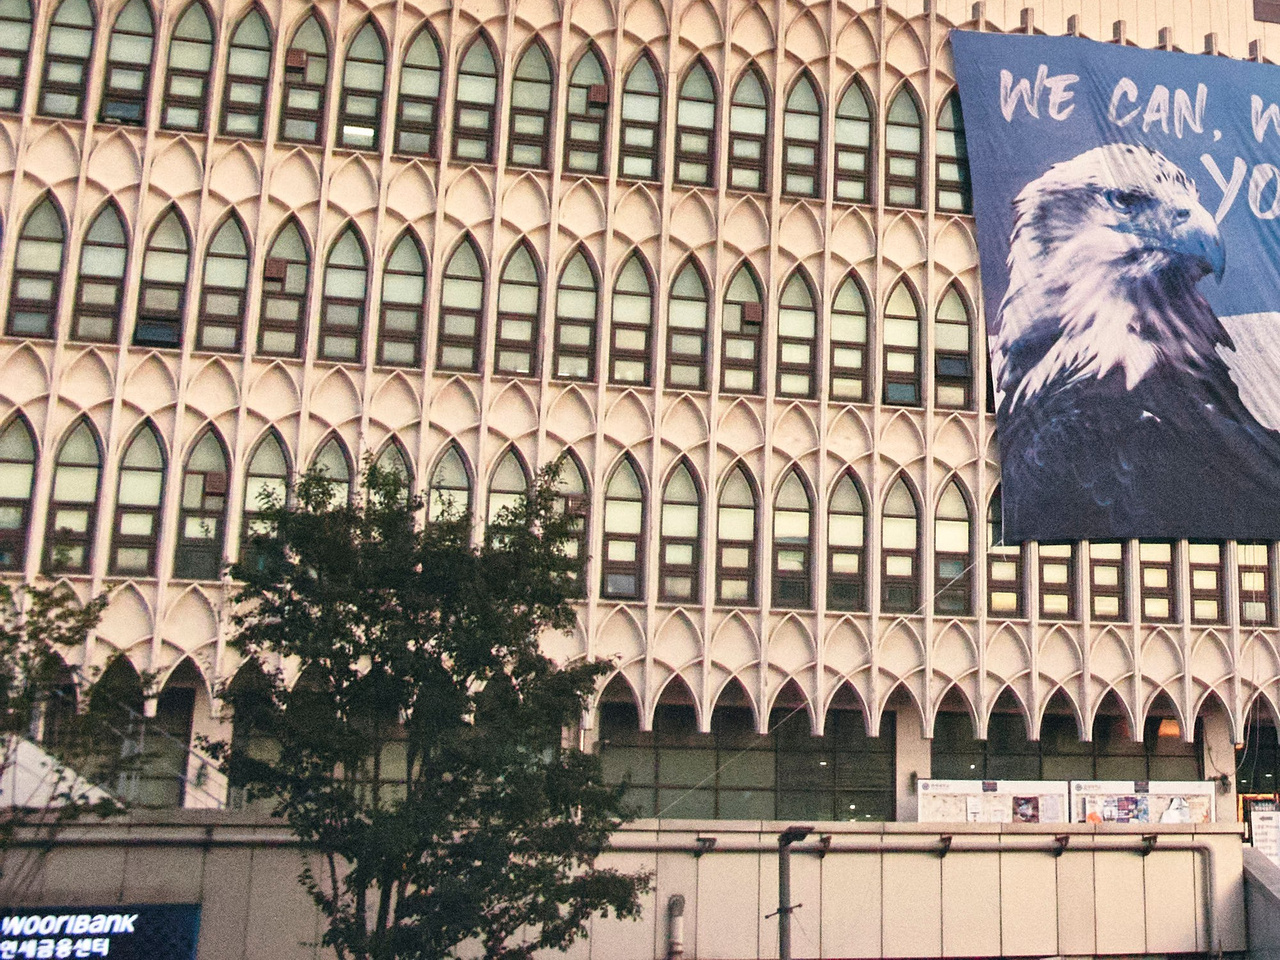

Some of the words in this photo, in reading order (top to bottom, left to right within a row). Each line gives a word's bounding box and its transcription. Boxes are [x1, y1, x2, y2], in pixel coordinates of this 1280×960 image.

[999, 64, 1080, 123] WE
[1108, 78, 1222, 142] CAN,
[0, 937, 110, 960] 연세금융센터
